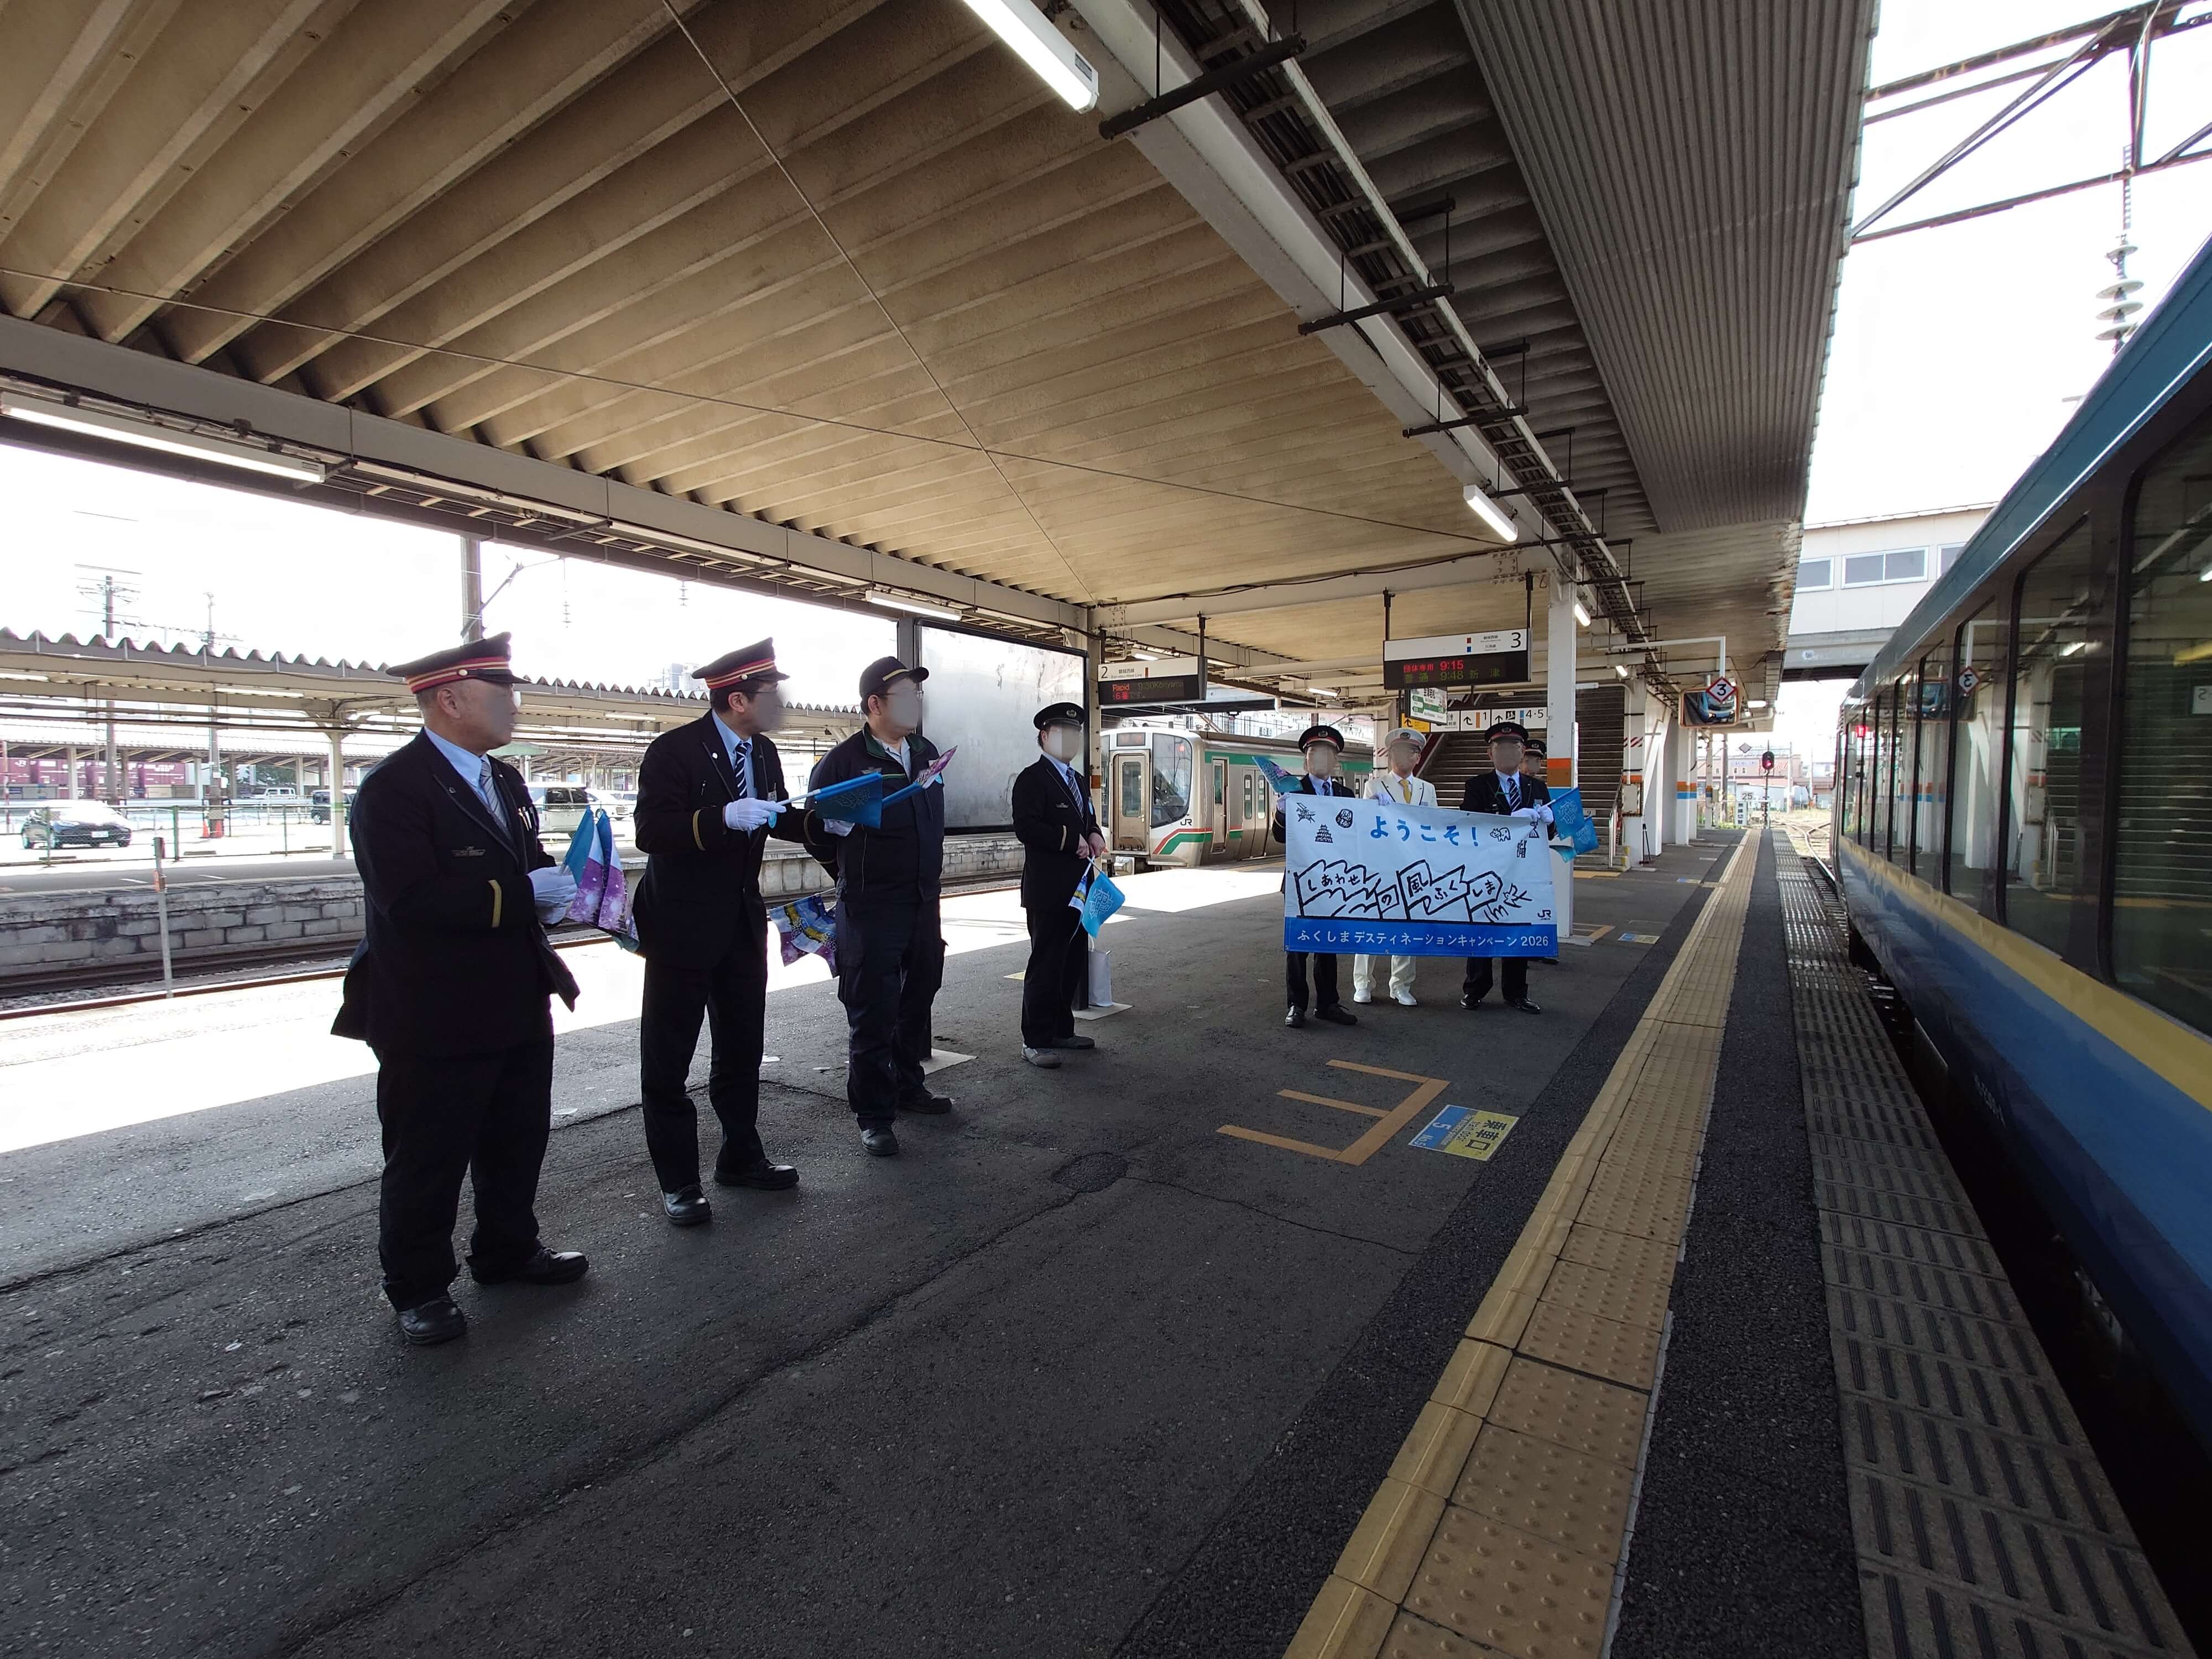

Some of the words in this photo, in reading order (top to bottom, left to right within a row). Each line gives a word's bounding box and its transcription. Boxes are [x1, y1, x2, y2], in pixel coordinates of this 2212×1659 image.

[1510, 632, 1521, 648] 3
[1439, 660, 1464, 671] 9:15
[1101, 666, 1108, 679] 2
[1440, 671, 1464, 681] 9:48
[1112, 684, 1130, 692] Rapid
[1717, 684, 1726, 696] 3
[1483, 711, 1486, 721] 1
[1742, 792, 1753, 800] 25
[1537, 910, 1552, 918] JR
[1521, 936, 1548, 947] 2026
